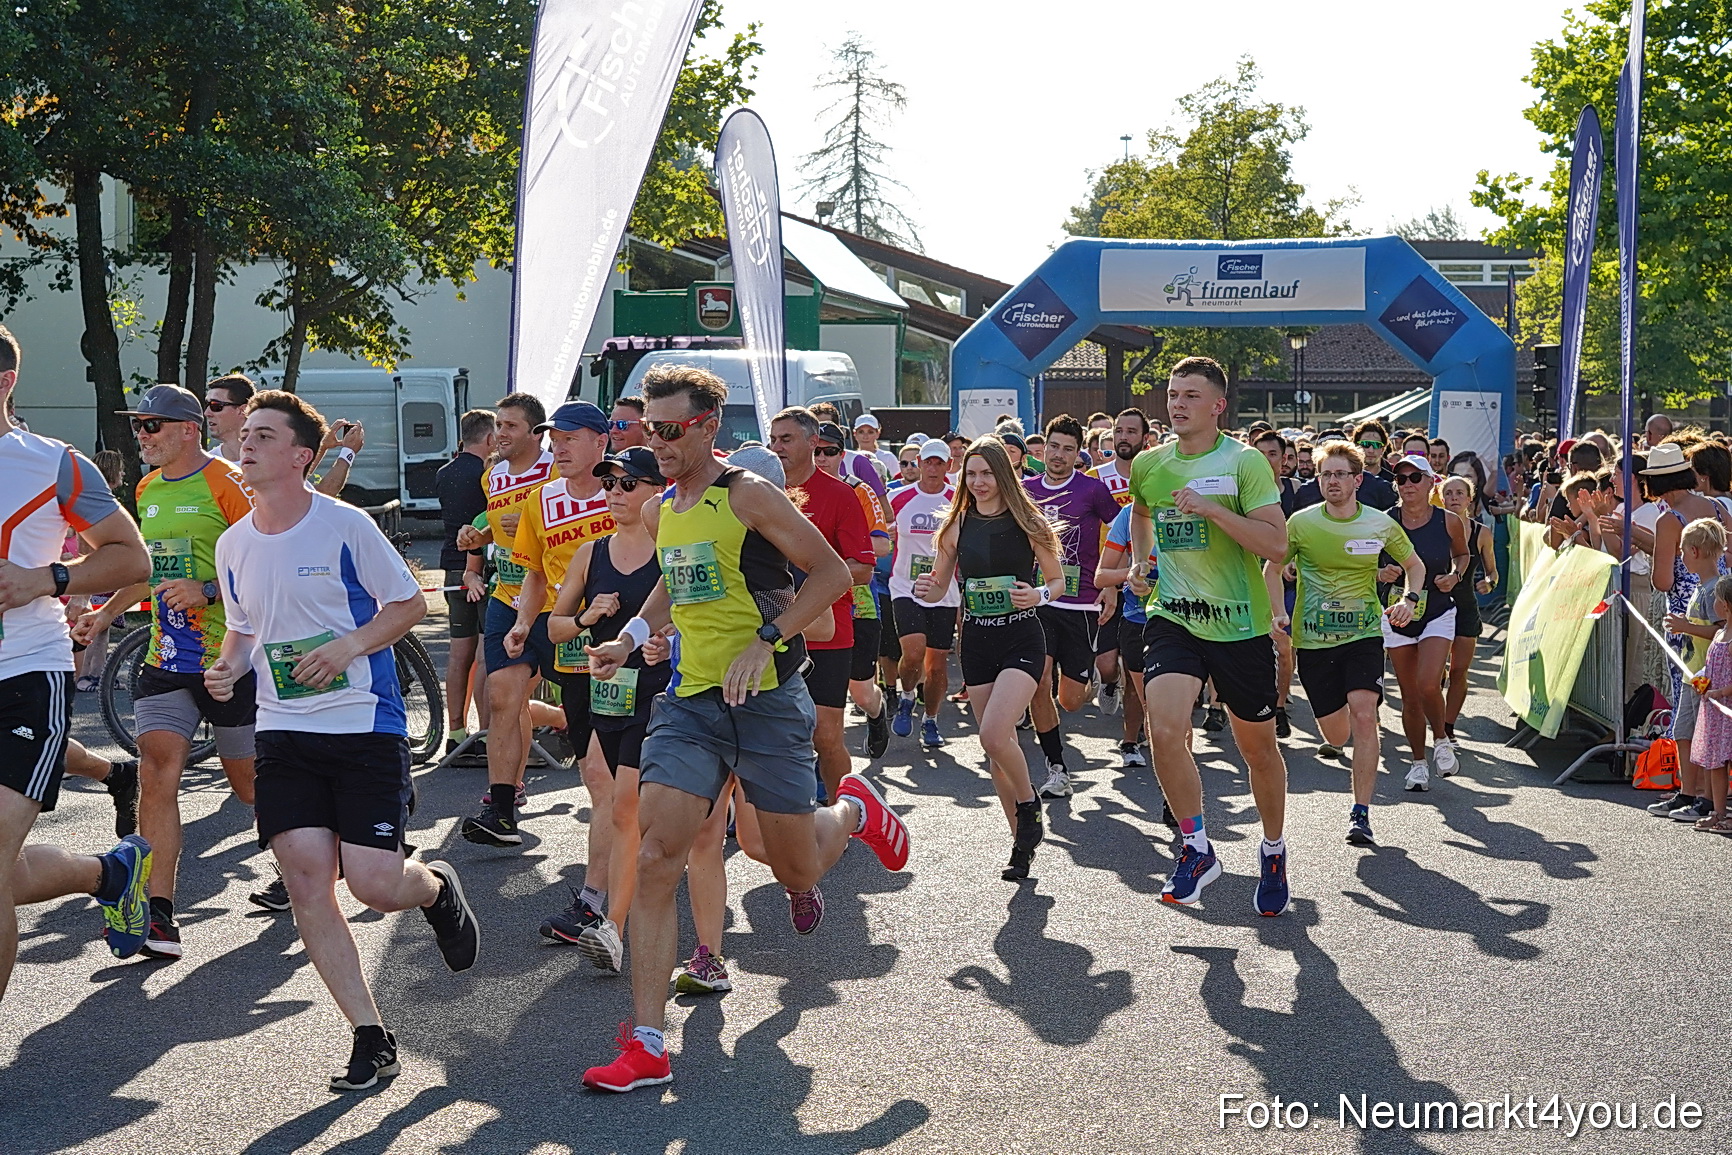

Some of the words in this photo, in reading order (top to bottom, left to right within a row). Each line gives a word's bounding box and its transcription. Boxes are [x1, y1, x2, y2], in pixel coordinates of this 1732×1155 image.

[1200, 280, 1300, 298] firmenlauf
[1008, 309, 1065, 323] Fischer
[1396, 312, 1411, 322] und
[1412, 310, 1426, 319] das
[487, 496, 511, 512] MAX
[514, 487, 532, 503] BÖ
[546, 525, 586, 549] MAX
[590, 515, 618, 535] BÖ
[1166, 521, 1194, 538] 679
[1199, 523, 1207, 544] 2022
[153, 555, 180, 572] 622
[184, 556, 193, 579] 2022
[664, 573, 672, 594] RUN
[669, 563, 708, 586] 1596
[707, 565, 720, 592] 2022
[689, 584, 710, 593] Tobias
[977, 590, 1005, 605] 199
[975, 616, 1007, 627] NIKE
[1008, 607, 1036, 624] PRO
[1330, 611, 1354, 624] 160
[273, 668, 284, 689] RUN
[594, 681, 620, 700] 480
[625, 688, 634, 710] 2022
[11, 729, 35, 741] adidas
